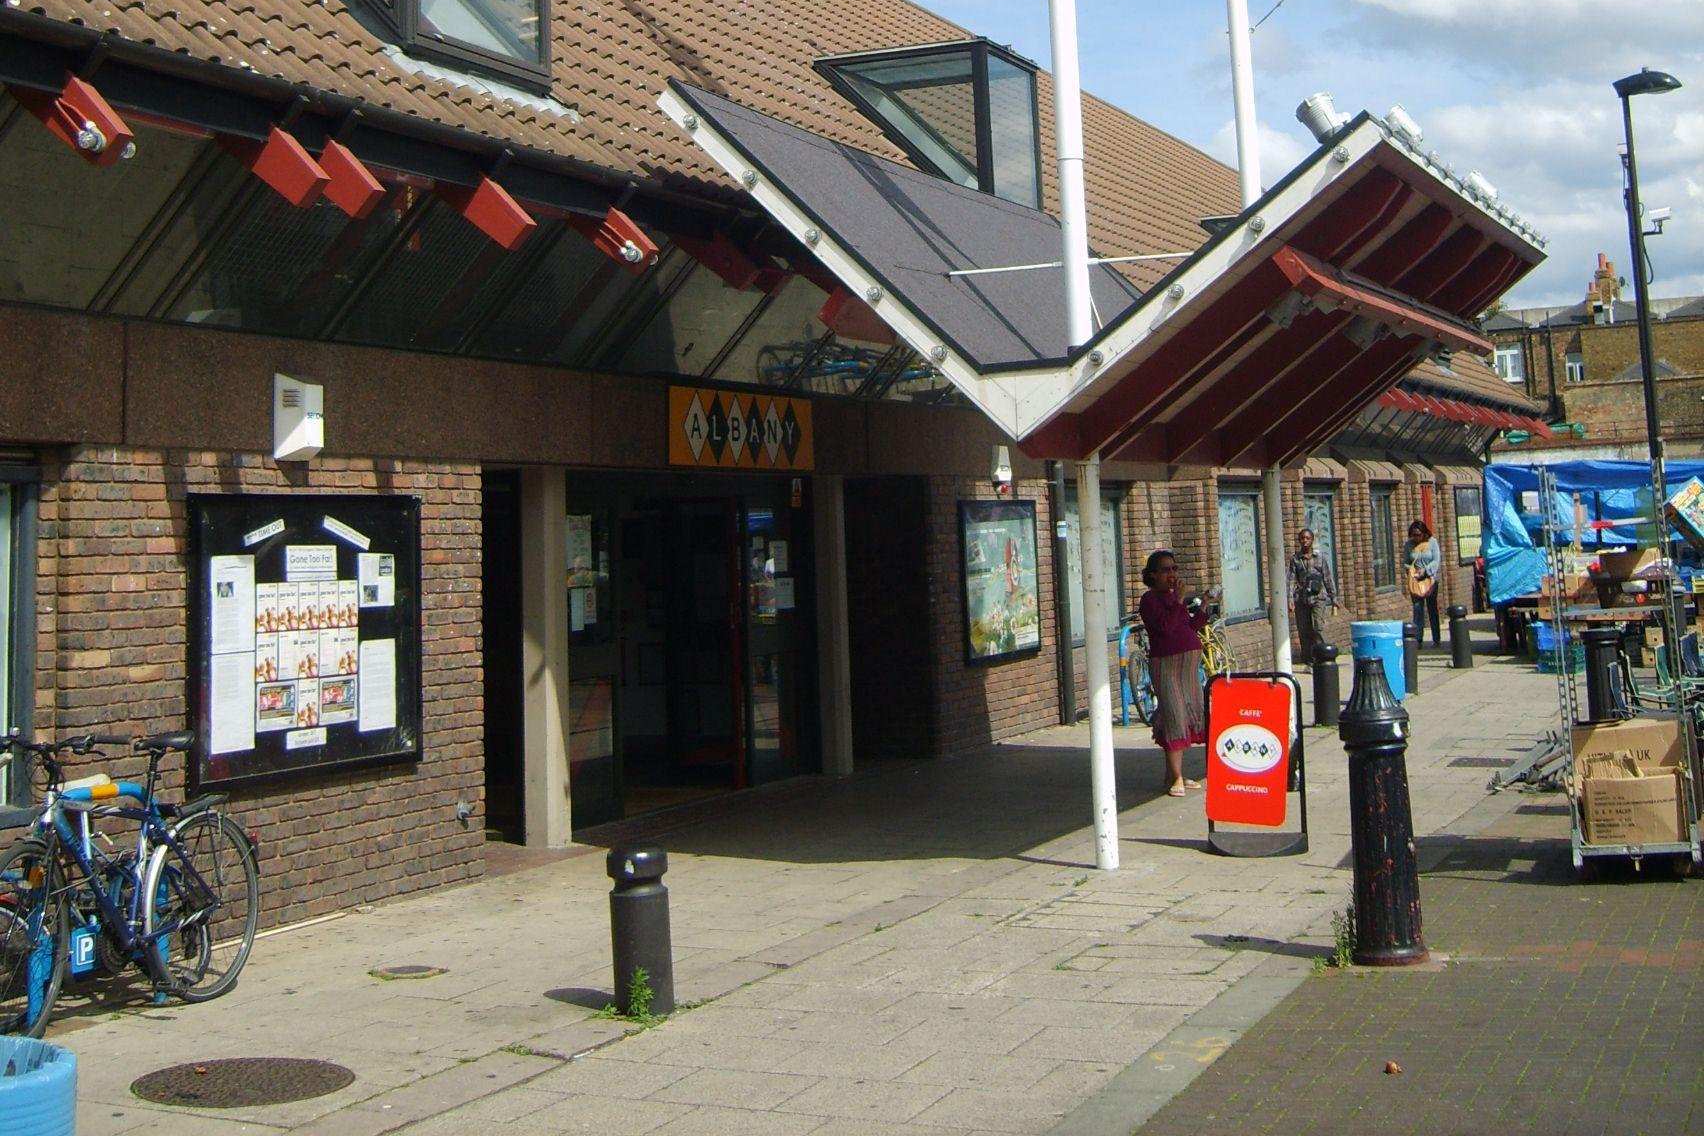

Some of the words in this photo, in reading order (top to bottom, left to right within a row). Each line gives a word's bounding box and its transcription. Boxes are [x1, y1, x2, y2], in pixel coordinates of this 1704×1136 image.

[690, 412, 795, 446] ALBANY
[290, 554, 308, 564] Gone
[309, 554, 321, 563] Too
[1636, 748, 1652, 761] UK
[1225, 783, 1268, 794] CAPPUCCINO
[80, 937, 94, 962] P
